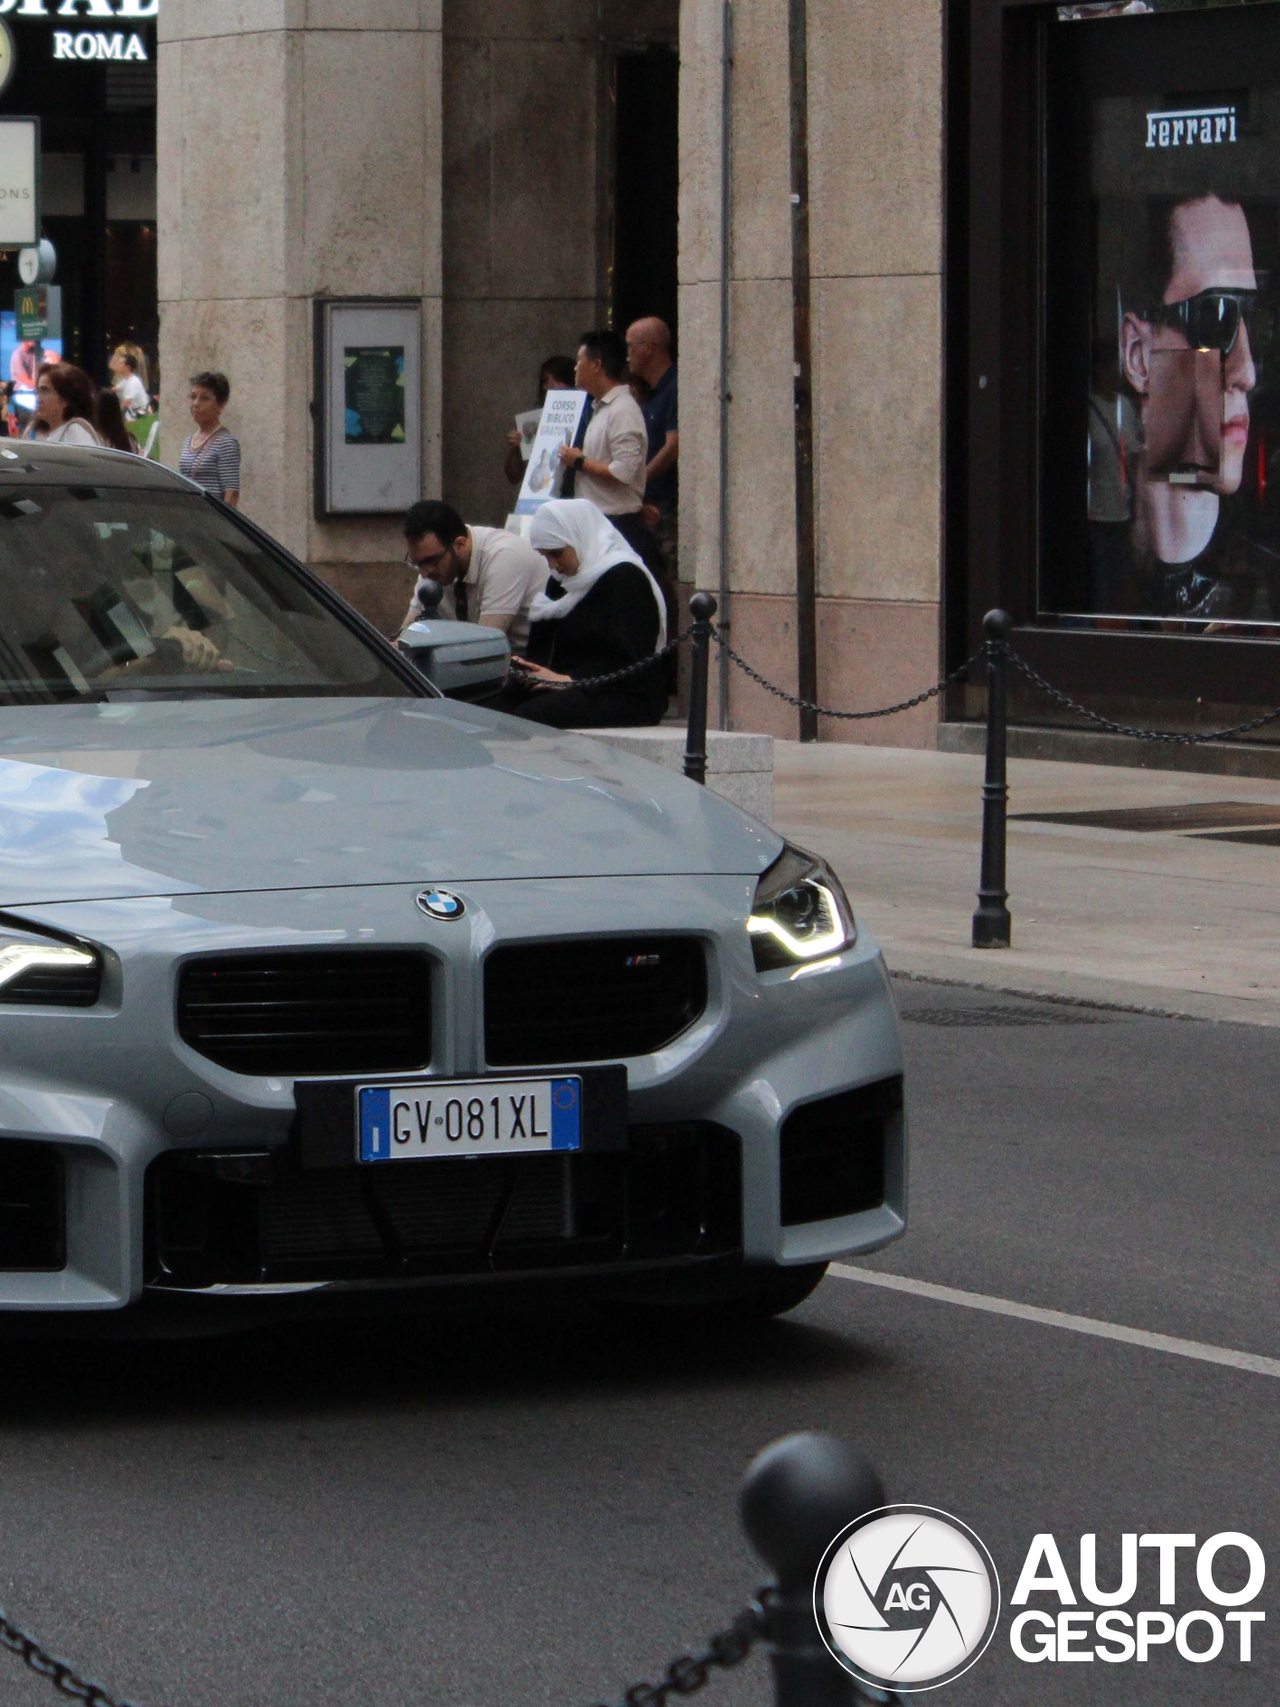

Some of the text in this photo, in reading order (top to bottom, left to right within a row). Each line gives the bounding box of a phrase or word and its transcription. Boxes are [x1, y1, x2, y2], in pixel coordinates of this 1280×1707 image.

[53, 33, 147, 60] ROMA
[1145, 107, 1236, 147] Ferrari
[552, 401, 576, 410] CORSO
[546, 413, 575, 423] BIBLICO
